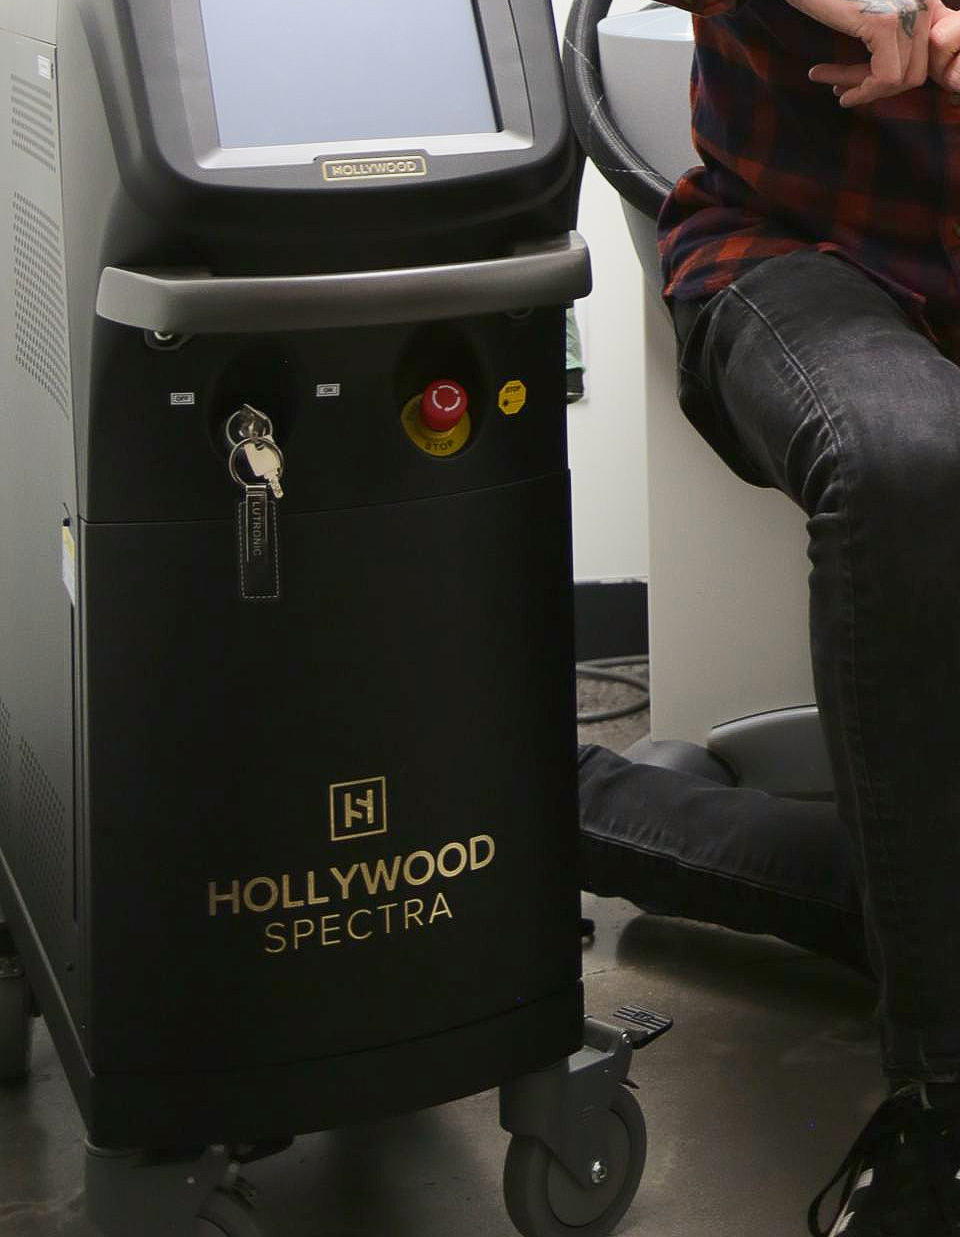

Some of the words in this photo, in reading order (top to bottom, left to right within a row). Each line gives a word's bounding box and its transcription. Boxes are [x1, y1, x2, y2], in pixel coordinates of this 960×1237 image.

[332, 161, 416, 176] HOLLYWOOD
[424, 439, 454, 451] STOP
[251, 501, 263, 557] LUTRONIC
[207, 834, 496, 917] HOLLYWOOD
[264, 892, 453, 954] SPECTRA
